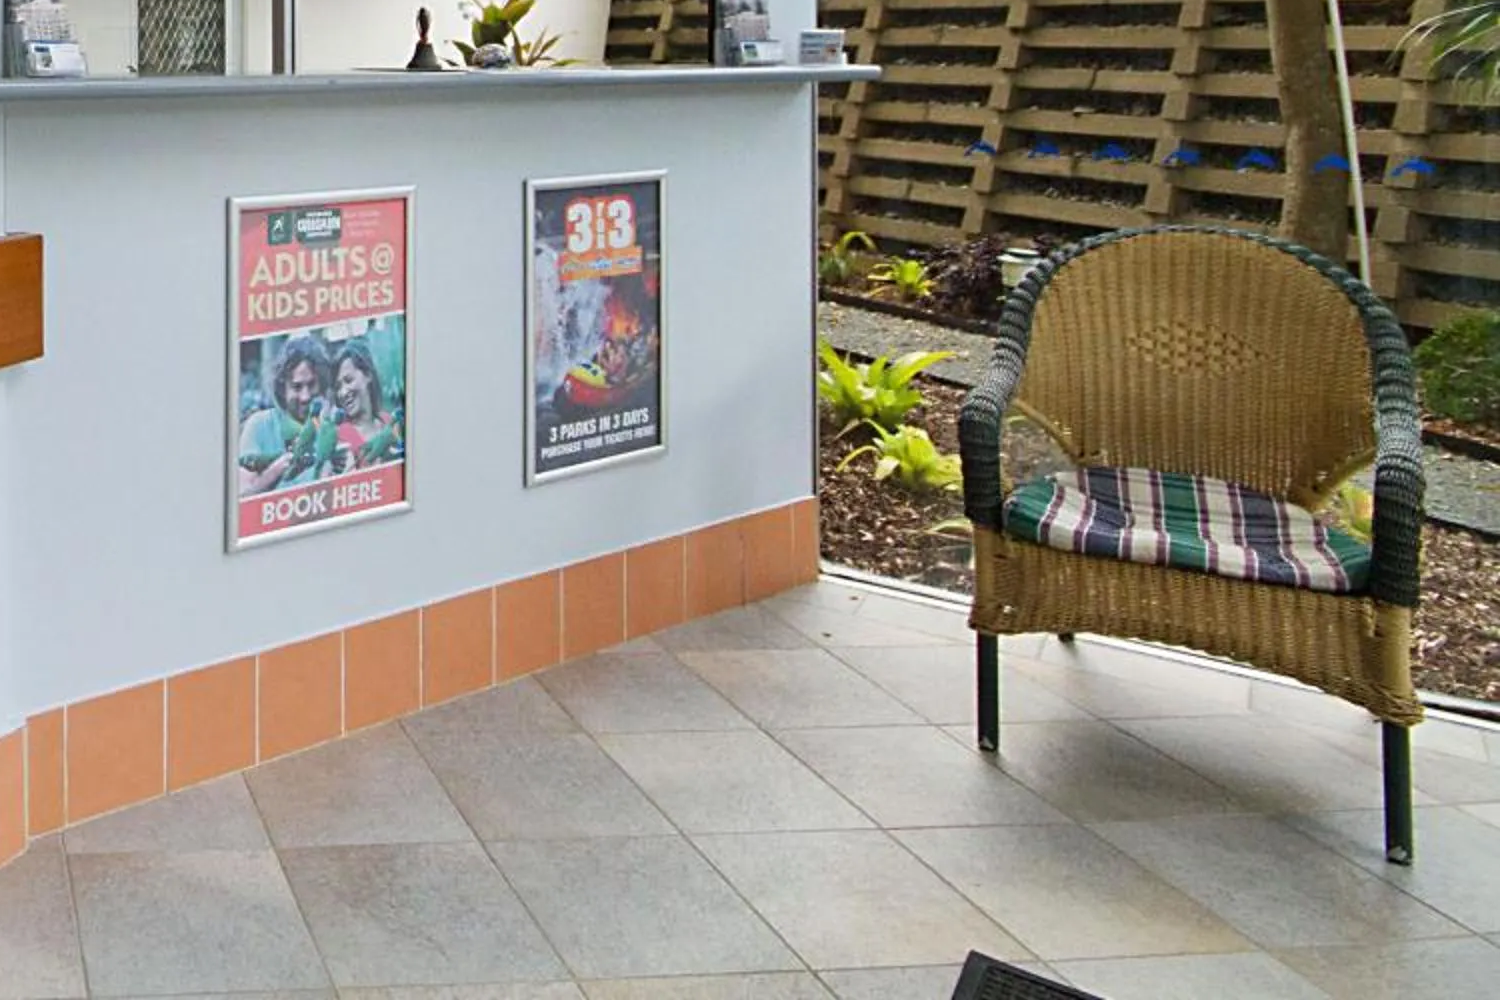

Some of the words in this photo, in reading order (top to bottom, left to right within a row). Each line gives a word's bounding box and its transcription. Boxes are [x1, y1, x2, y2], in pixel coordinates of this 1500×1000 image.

[250, 245, 367, 288] ADULTS
[370, 242, 394, 276] @
[248, 289, 309, 322] KIDS
[315, 280, 394, 314] PRICES
[550, 427, 557, 442] 3
[560, 419, 597, 440] PARKS
[599, 417, 611, 431] IN
[613, 414, 621, 428] 3
[623, 408, 650, 426] DAYS
[261, 490, 327, 525] BOOK
[332, 480, 382, 510] HERE
